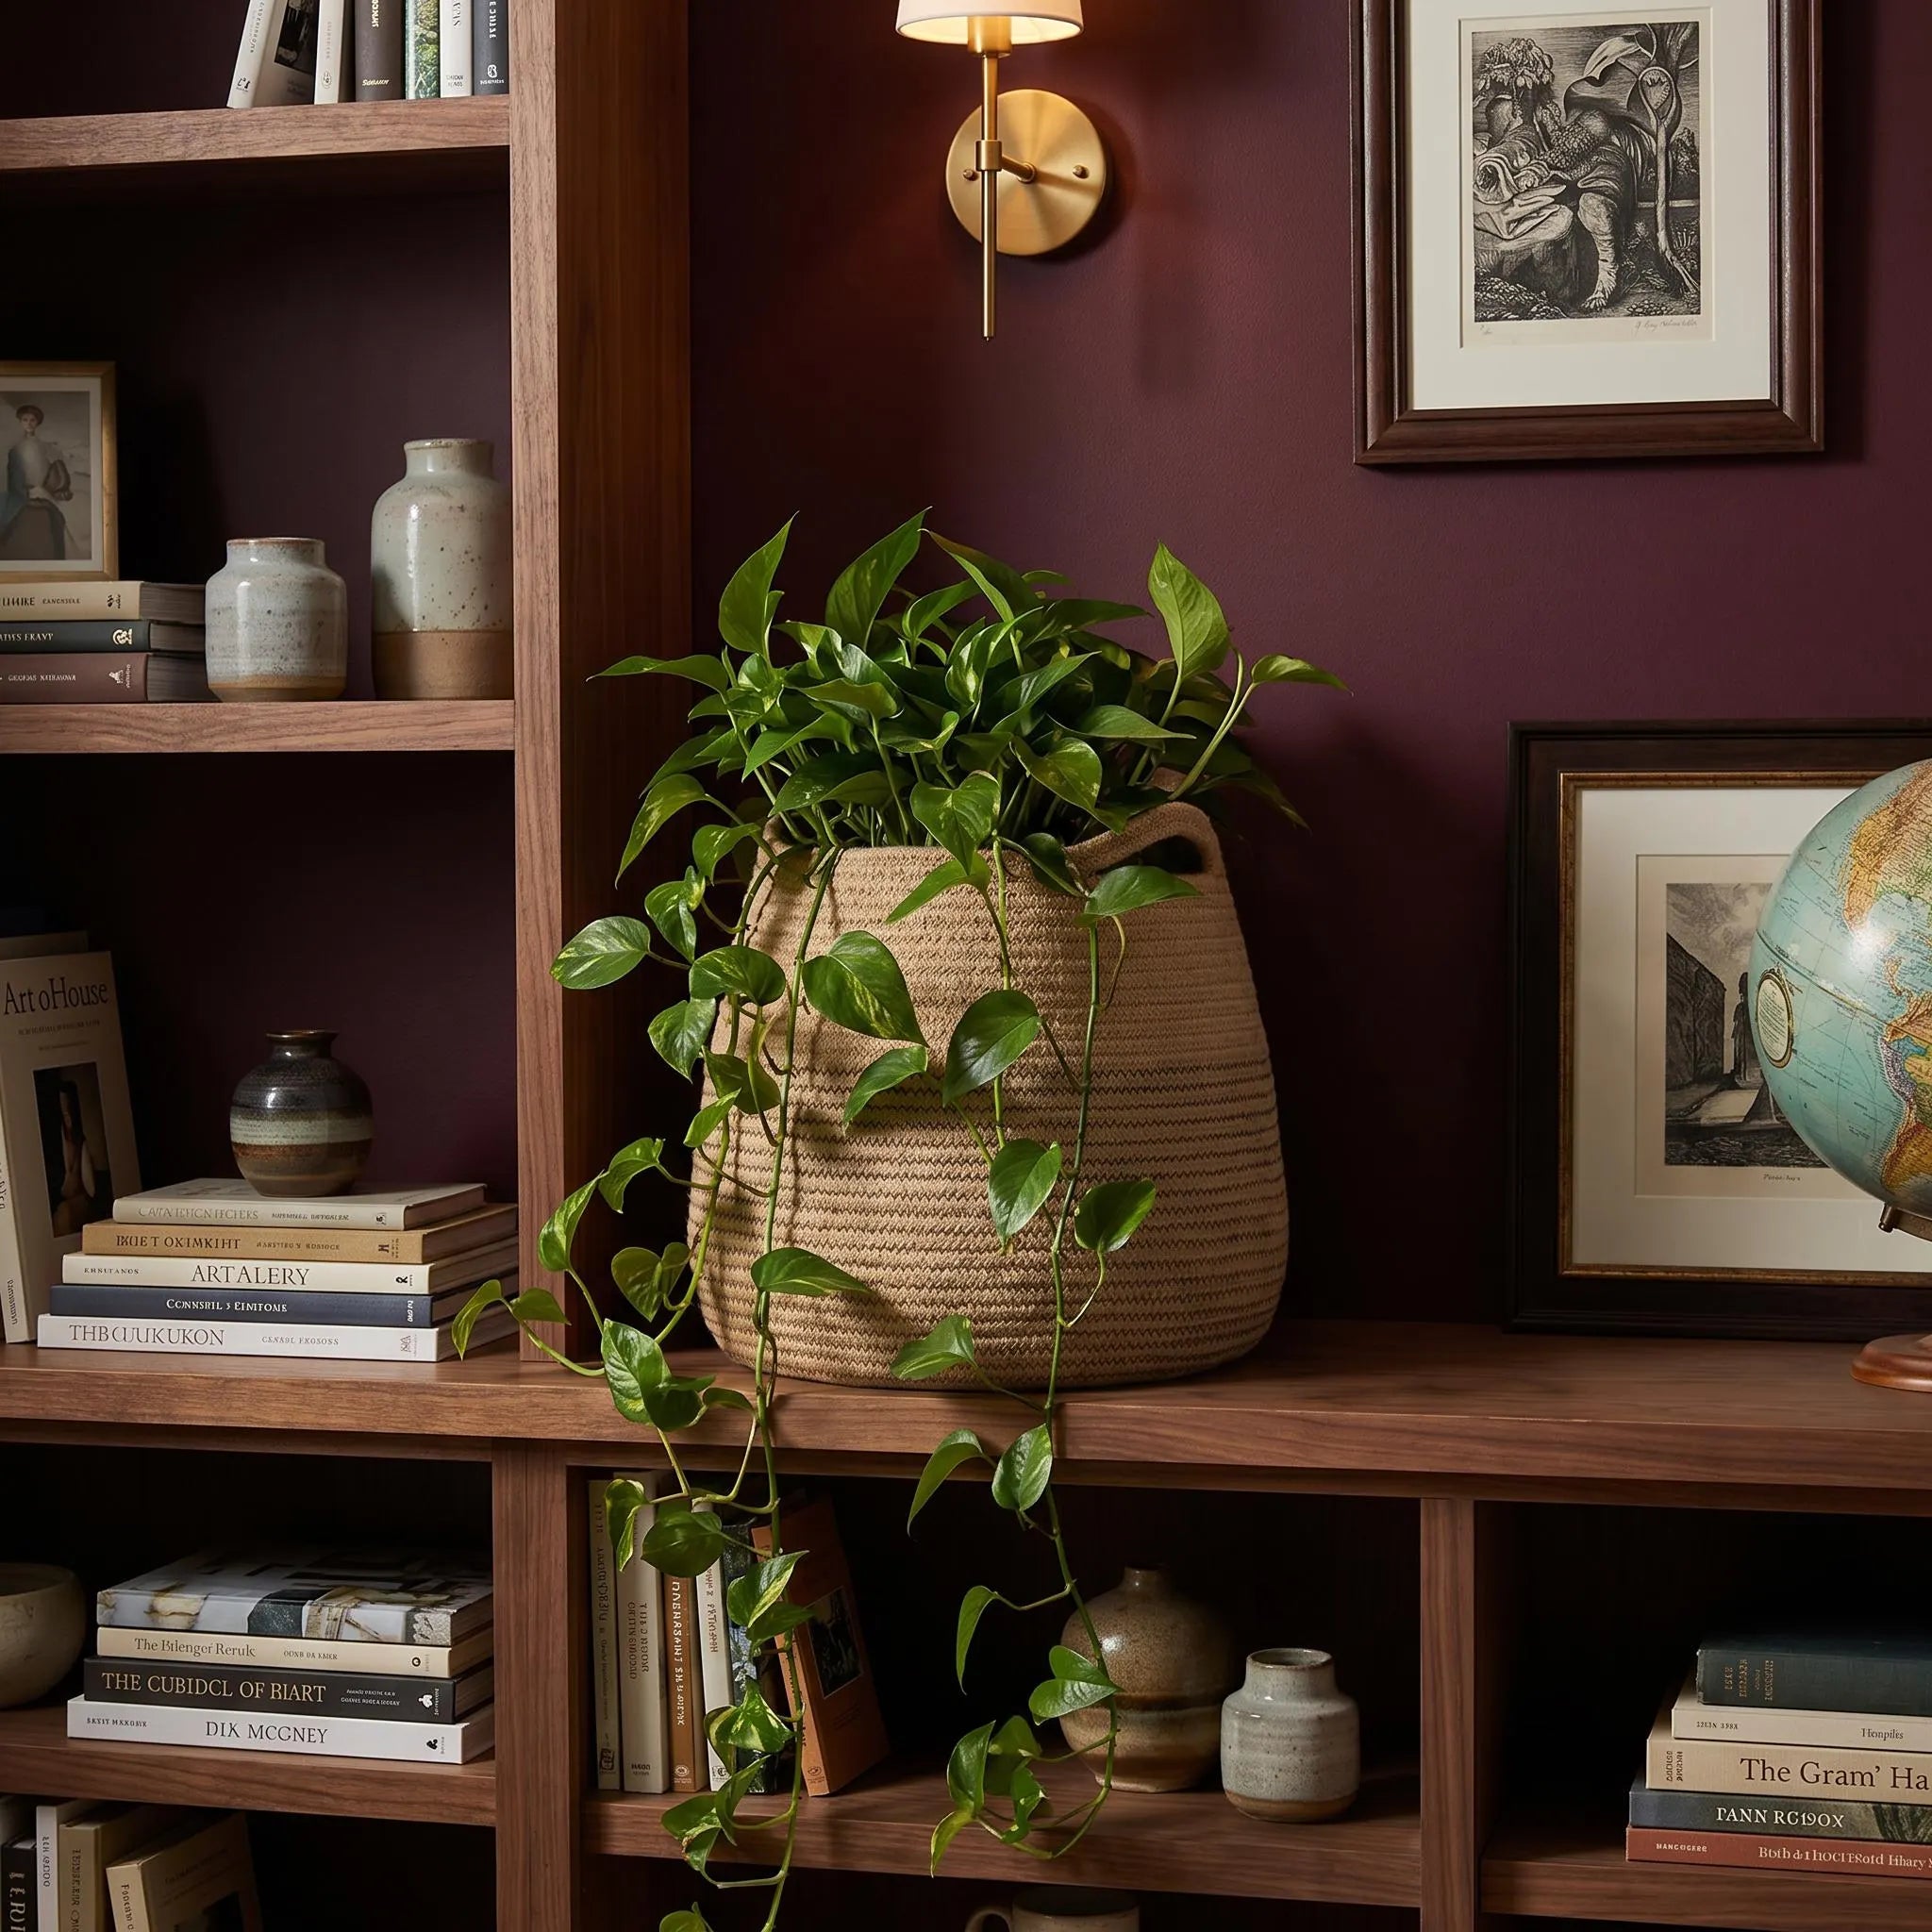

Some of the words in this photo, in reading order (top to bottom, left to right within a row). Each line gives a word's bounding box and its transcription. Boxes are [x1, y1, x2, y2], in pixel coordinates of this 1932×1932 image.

[4, 981, 35, 1015] Art
[135, 1638, 158, 1652] The
[102, 1673, 142, 1691] THE
[240, 1681, 265, 1699] OF
[271, 1683, 325, 1703] BIART
[1740, 1757, 1790, 1782] The
[1890, 1766, 1930, 1790] Ha
